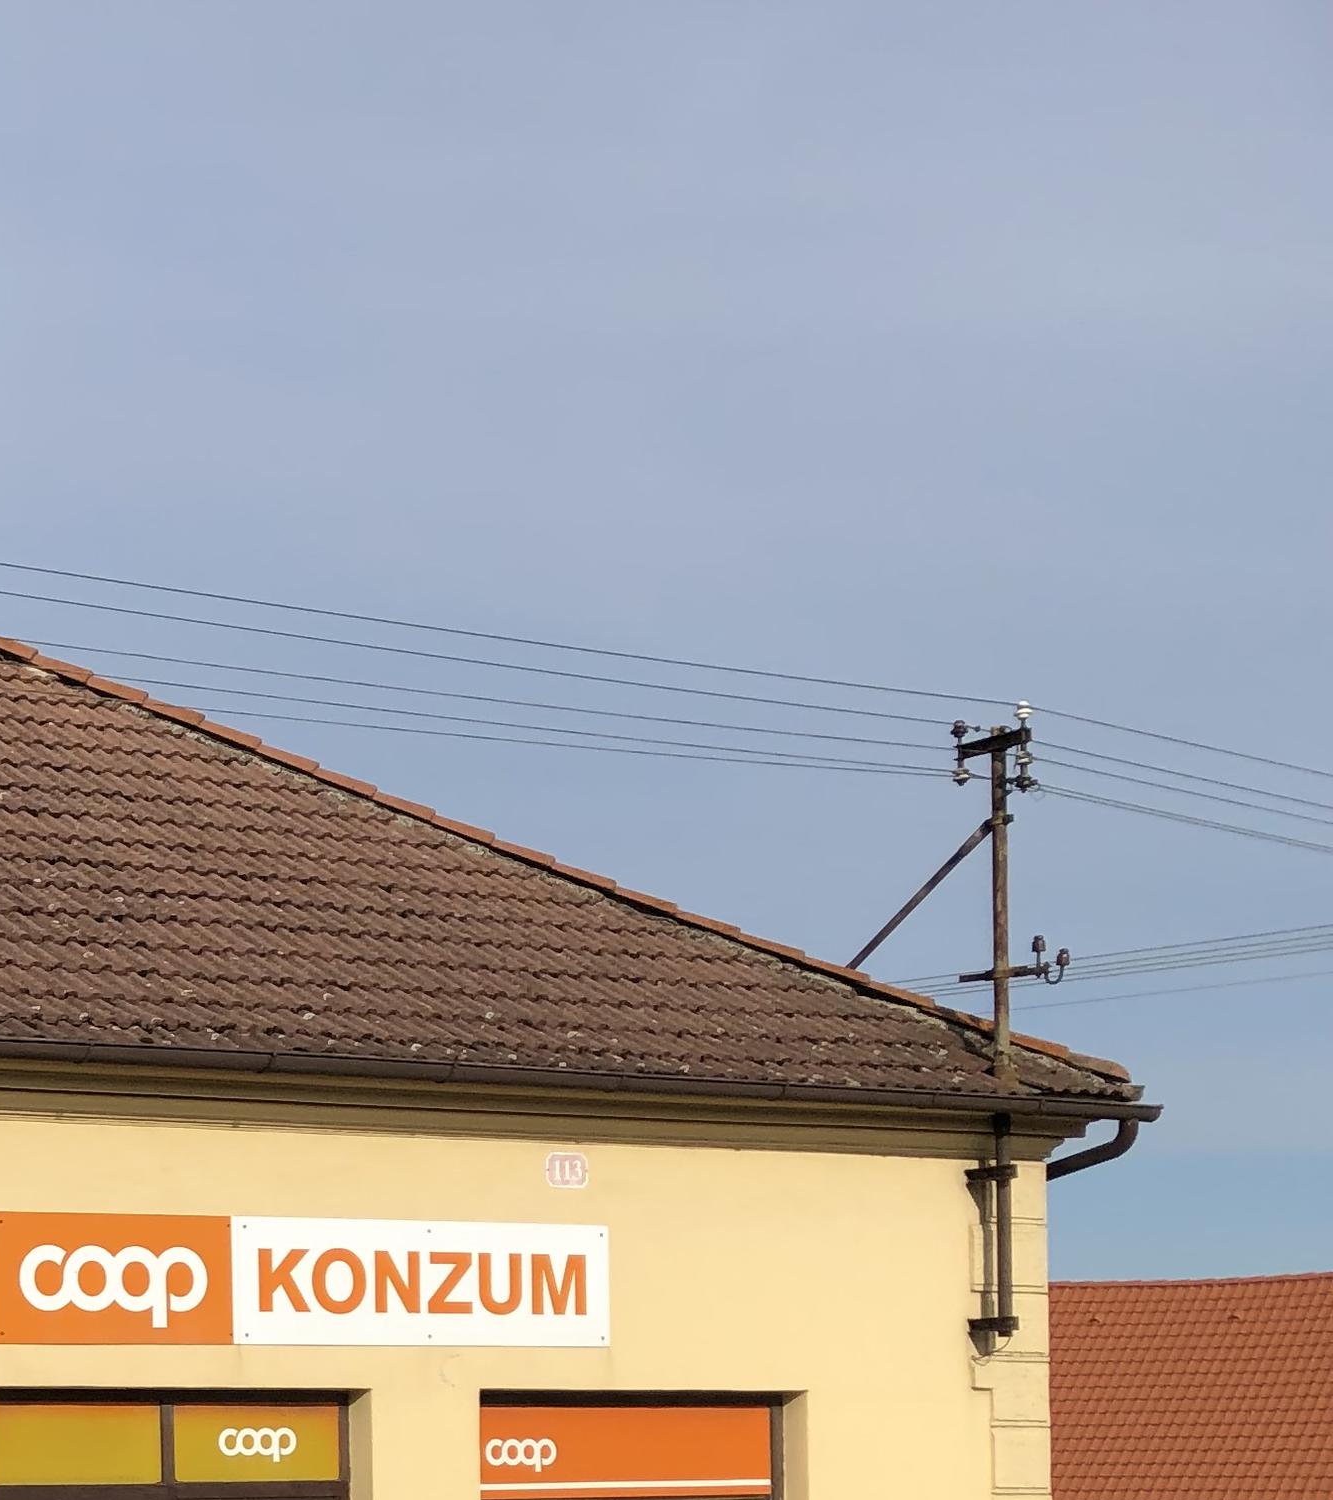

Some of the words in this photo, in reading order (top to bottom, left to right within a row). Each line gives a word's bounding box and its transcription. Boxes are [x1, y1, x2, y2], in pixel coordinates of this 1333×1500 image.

[553, 1159, 583, 1181] 113
[17, 1243, 210, 1329] coop
[257, 1247, 588, 1317] KONZUM
[217, 1426, 298, 1463] coop
[485, 1438, 558, 1473] coop
